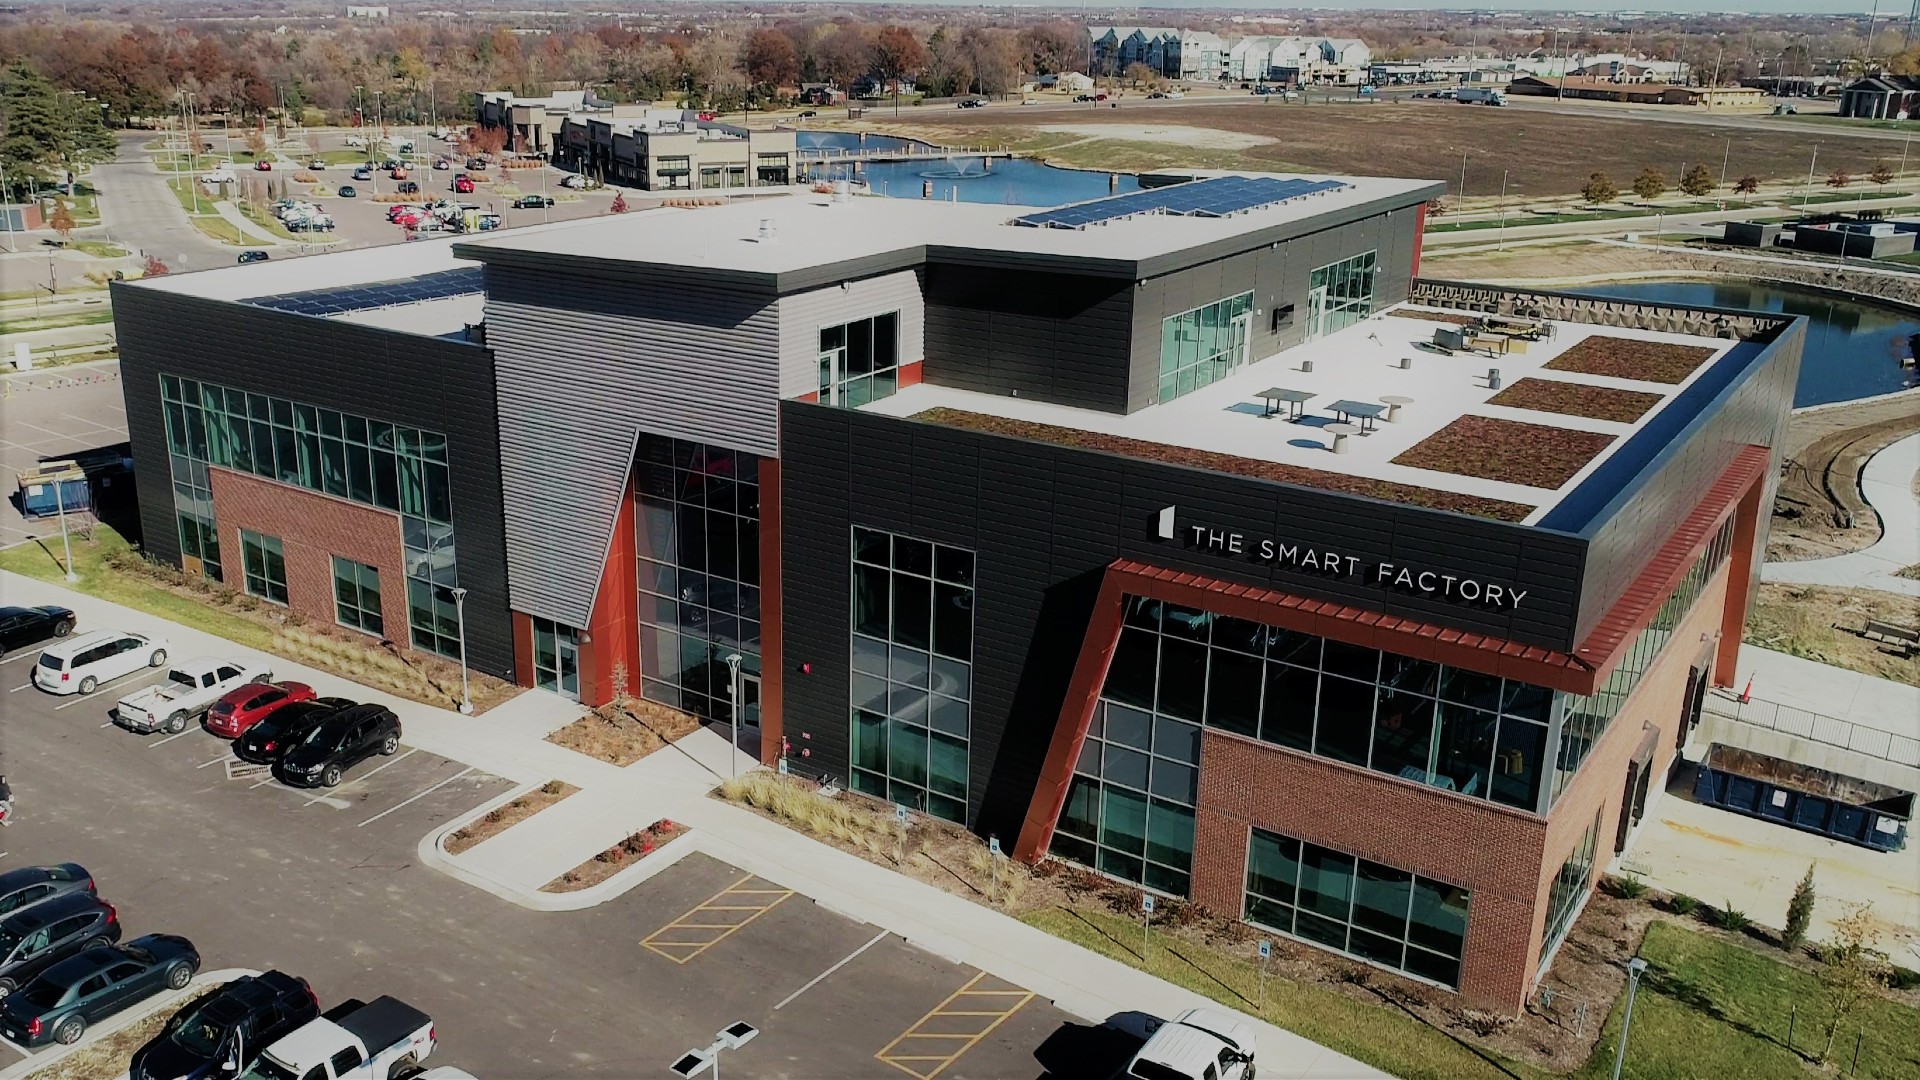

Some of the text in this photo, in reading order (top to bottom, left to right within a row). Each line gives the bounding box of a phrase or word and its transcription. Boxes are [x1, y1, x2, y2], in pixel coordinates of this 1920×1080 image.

[1192, 525, 1527, 609] THE SMART FACTORY
